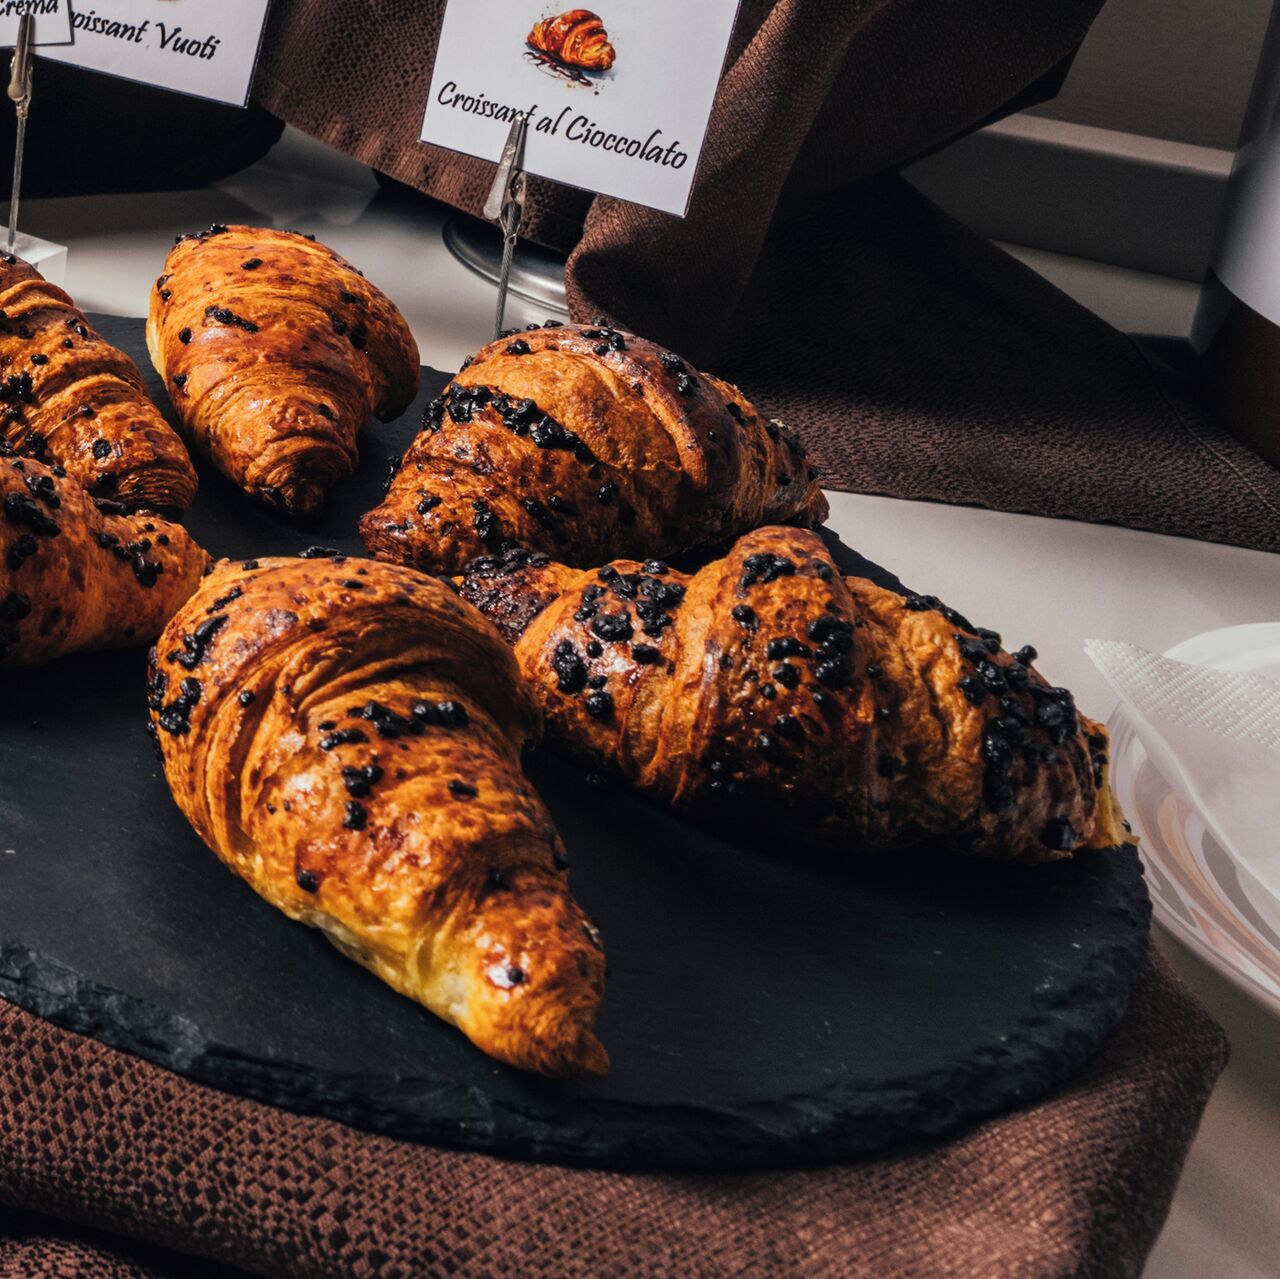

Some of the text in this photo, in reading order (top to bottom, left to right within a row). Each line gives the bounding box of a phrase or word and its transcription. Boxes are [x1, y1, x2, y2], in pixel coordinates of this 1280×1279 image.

[70, 10, 222, 61] oissant Vuoti
[436, 80, 689, 171] Croissant al Cioccolato
